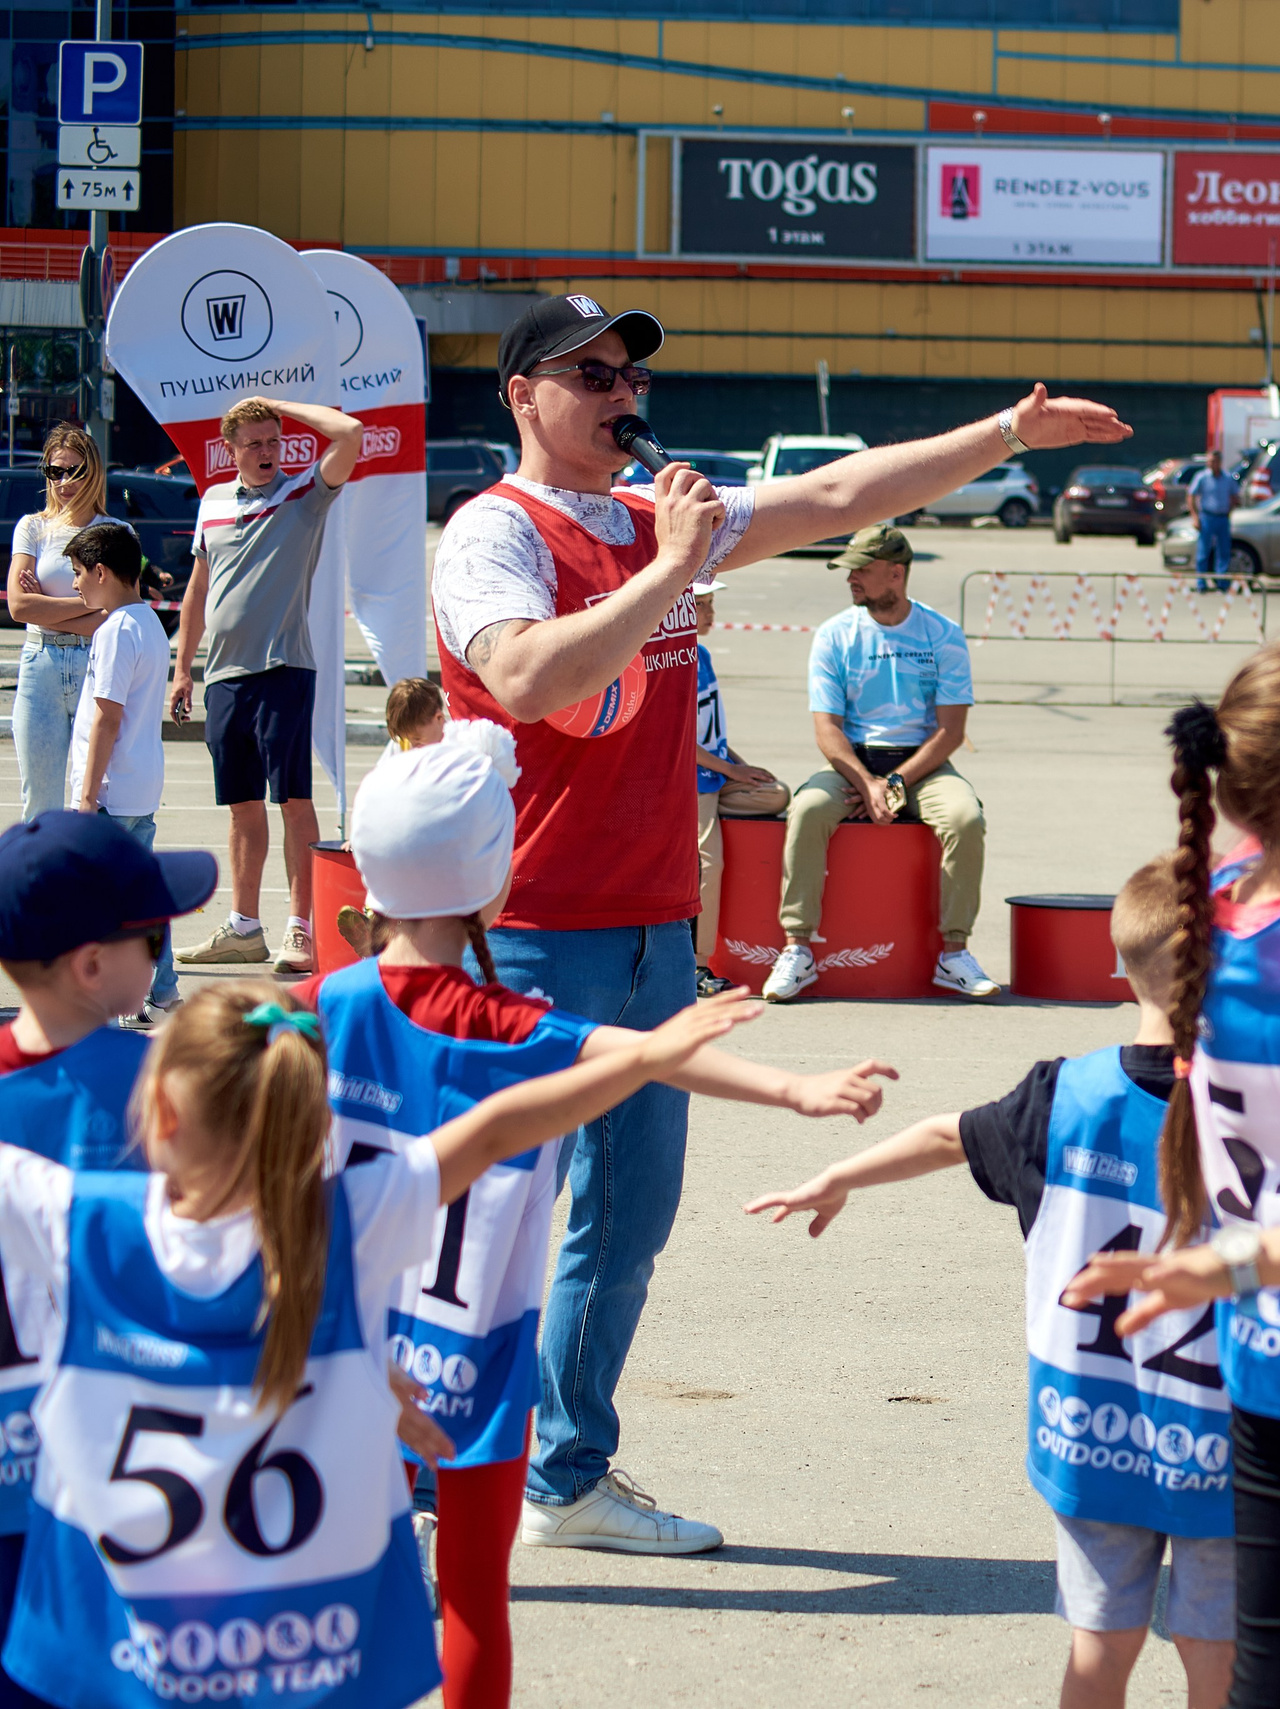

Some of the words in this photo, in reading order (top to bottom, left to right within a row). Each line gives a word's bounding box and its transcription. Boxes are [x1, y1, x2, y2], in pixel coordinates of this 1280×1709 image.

[83, 52, 127, 114] P
[995, 178, 1150, 199] RENDEZ-VOUS
[160, 364, 316, 398] ПУШКИНСКИЙ
[603, 684, 619, 724] DEMIX
[99, 1385, 324, 1565] 56
[1036, 1424, 1152, 1478] OUTDOOR
[1152, 1461, 1229, 1492] TEAM
